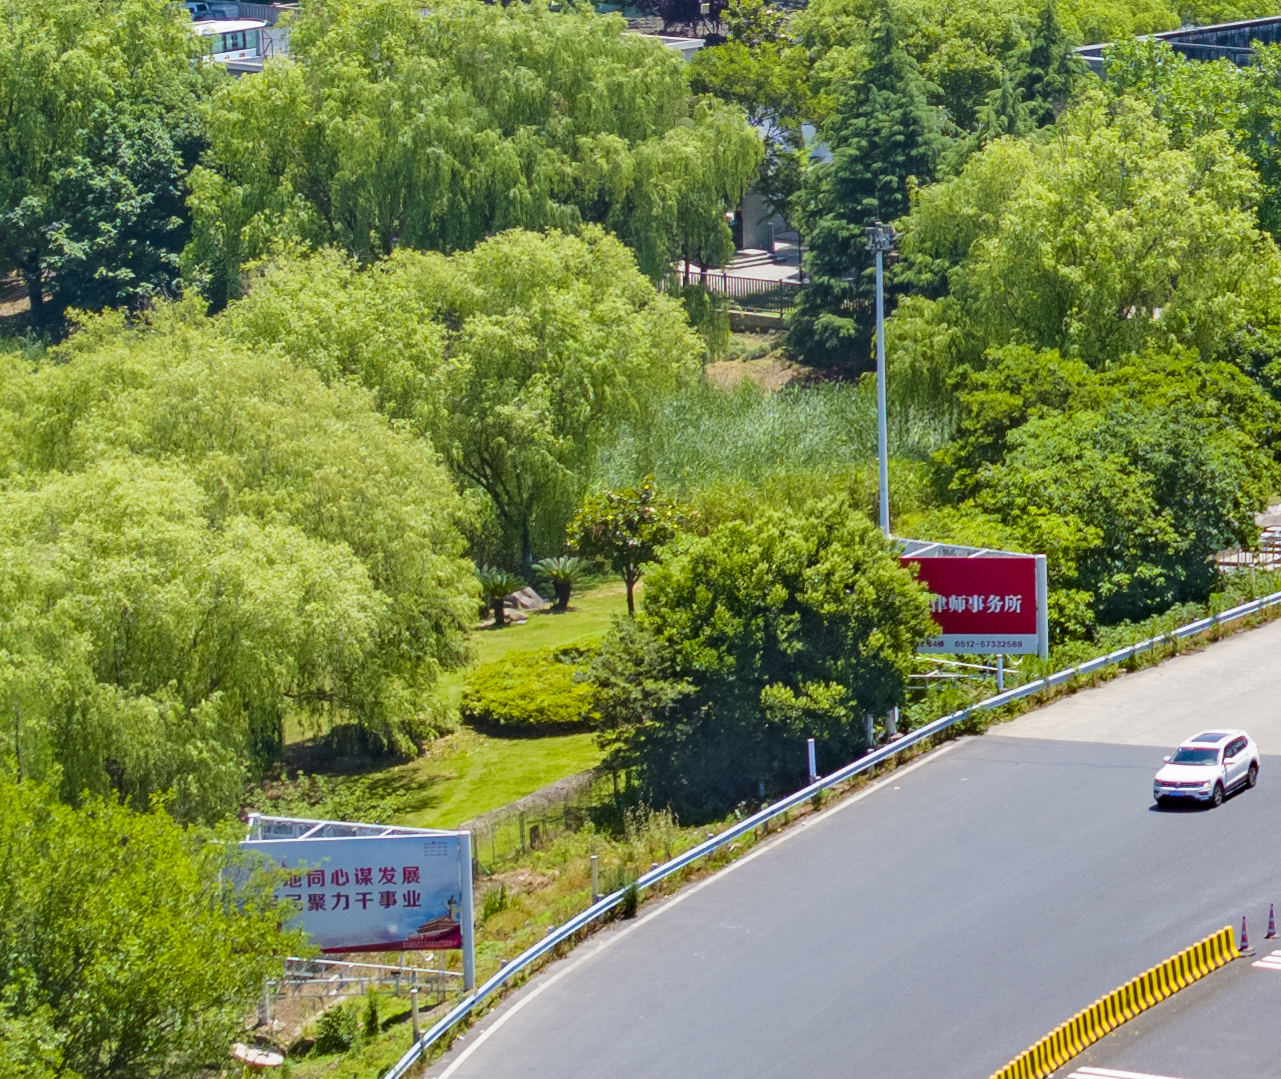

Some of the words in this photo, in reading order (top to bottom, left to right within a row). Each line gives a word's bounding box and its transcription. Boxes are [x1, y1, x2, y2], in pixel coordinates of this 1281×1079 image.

[278, 865, 422, 888] 地同心谋发展
[269, 889, 423, 913] 民聚力干事业
